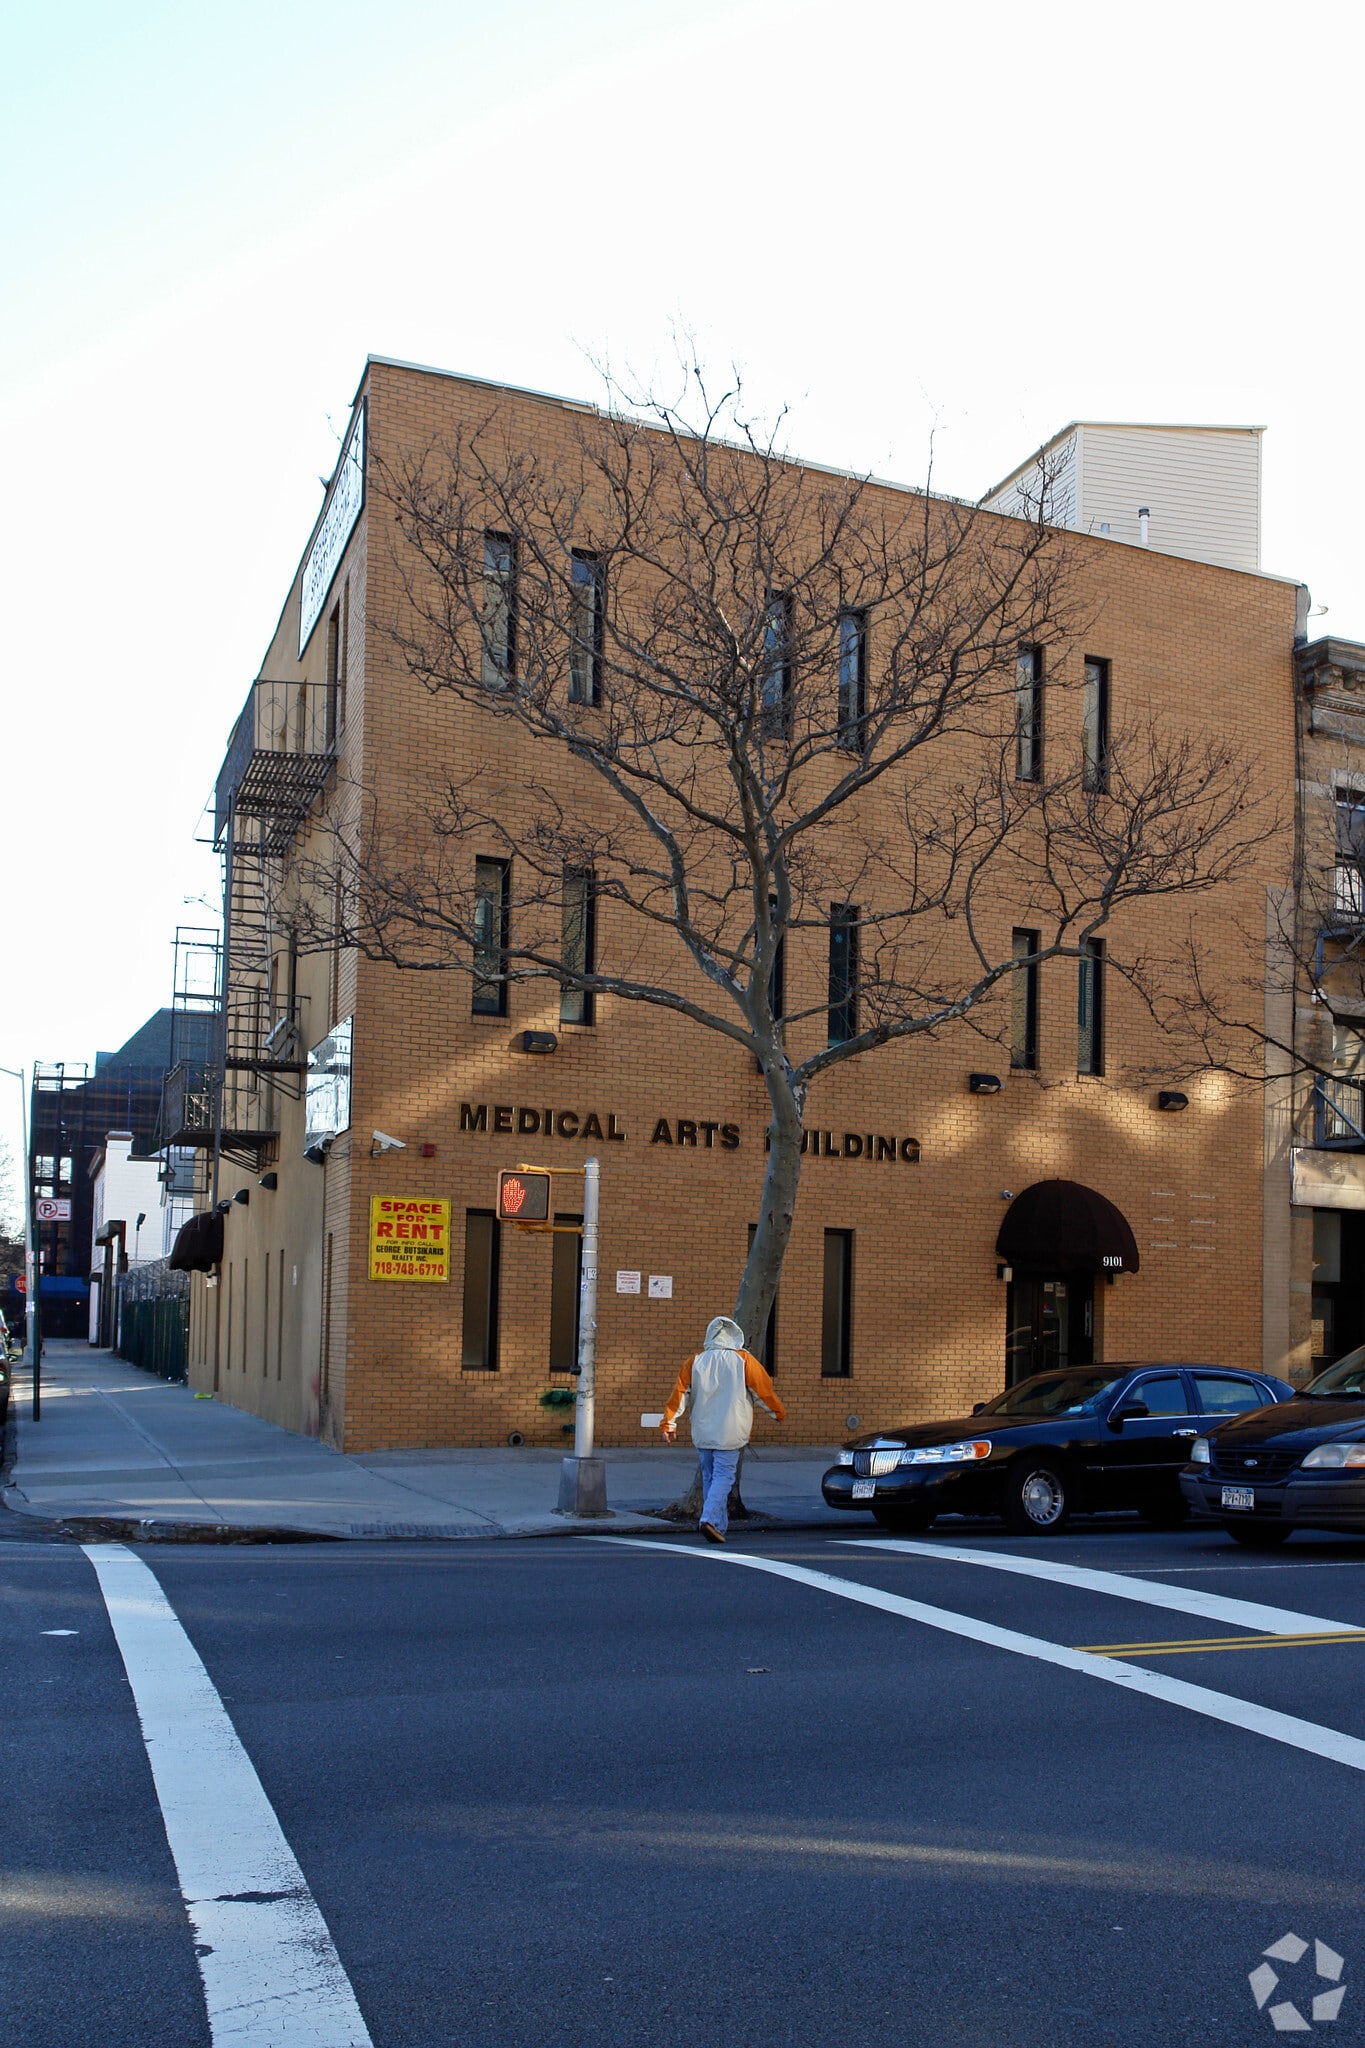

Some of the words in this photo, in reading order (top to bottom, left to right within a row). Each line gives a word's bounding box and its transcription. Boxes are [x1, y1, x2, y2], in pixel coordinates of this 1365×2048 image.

[459, 1102, 627, 1141] MEDICAL
[651, 1118, 741, 1150] ARTS
[765, 1128, 922, 1163] UILDING
[381, 1201, 442, 1214] SPACE
[396, 1214, 425, 1222] FOR
[377, 1222, 444, 1240] RENT
[376, 1245, 401, 1254] GEORGE
[1103, 1256, 1122, 1266] 9101
